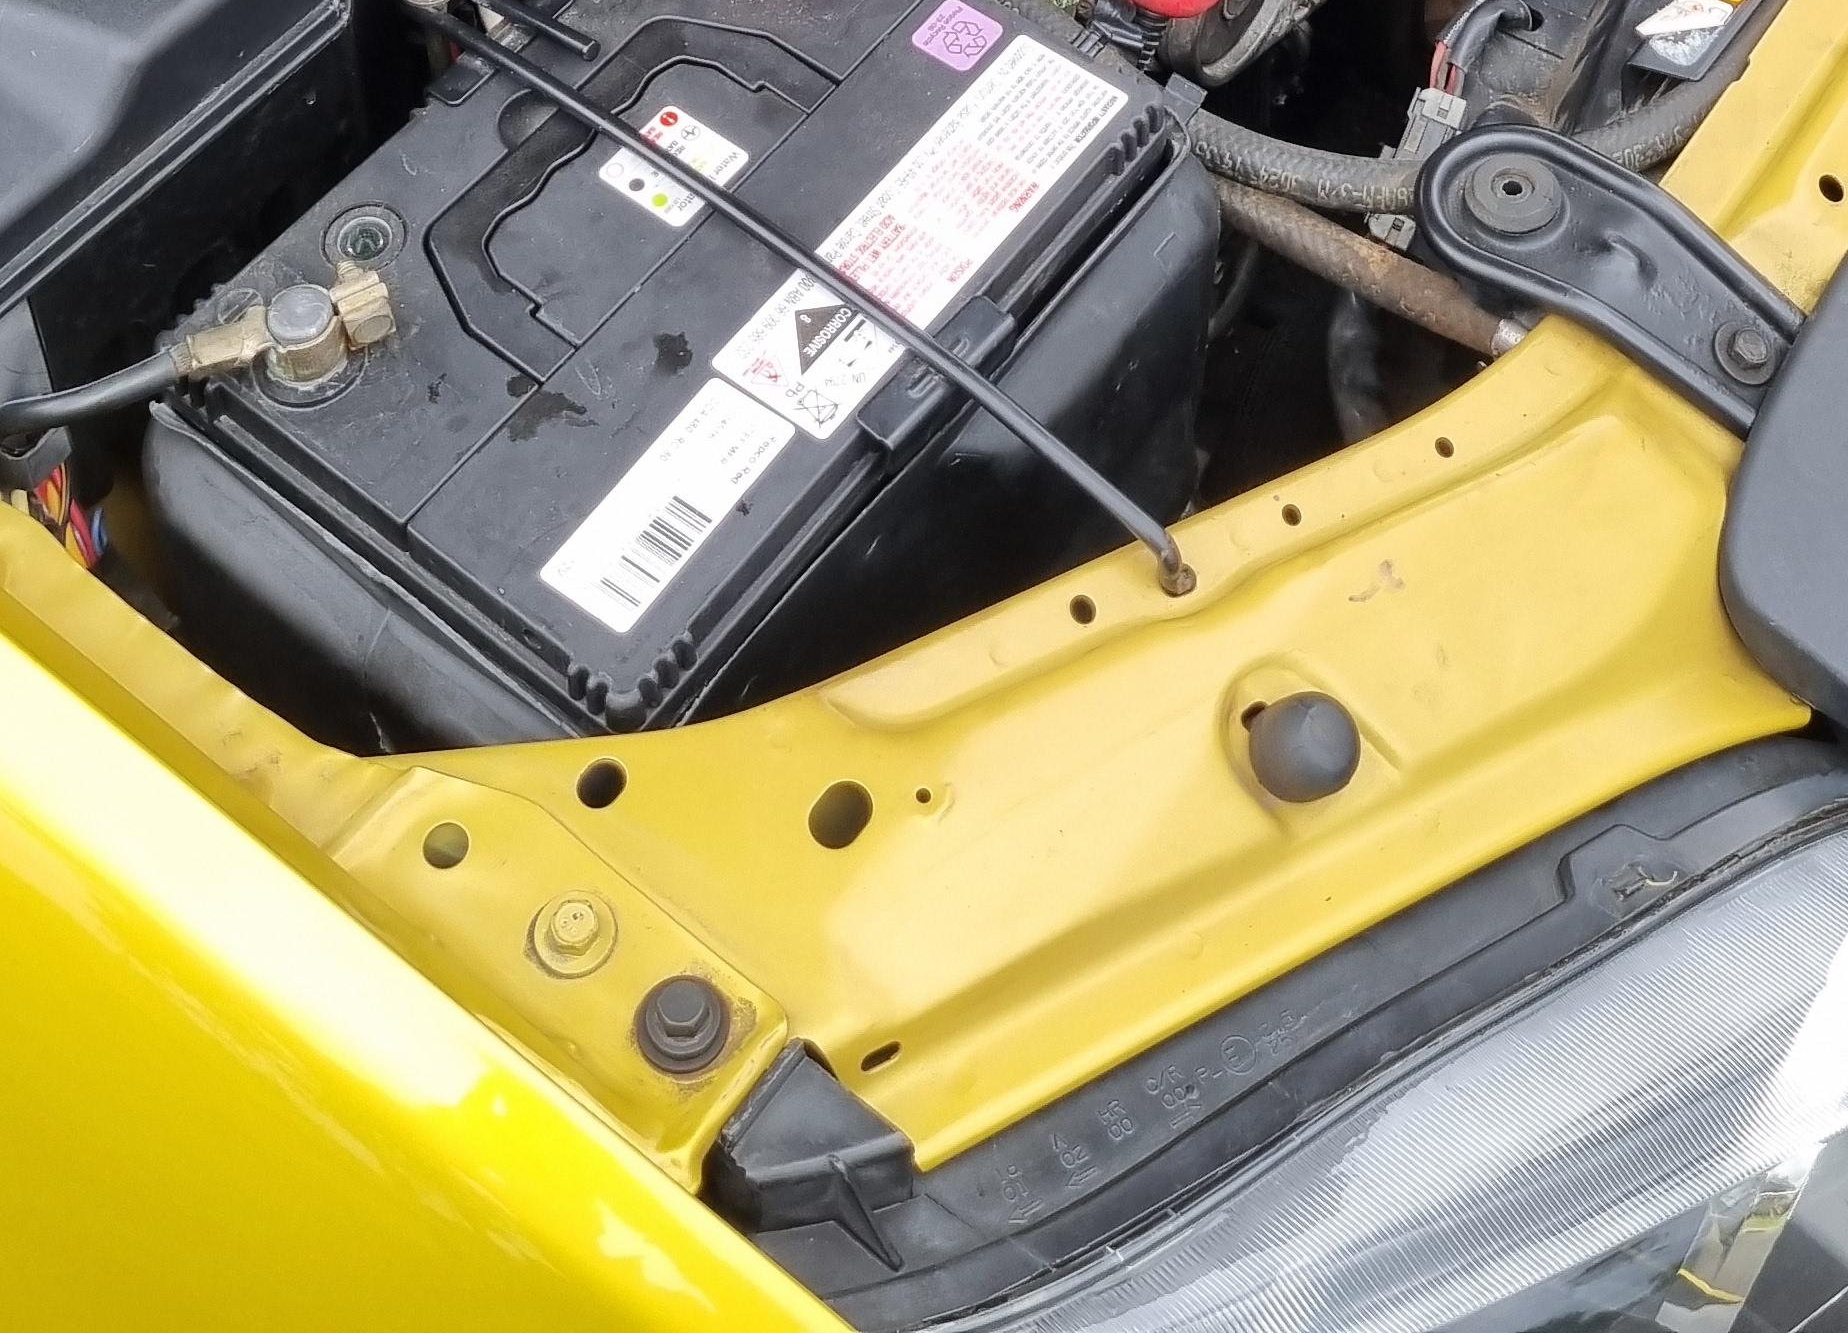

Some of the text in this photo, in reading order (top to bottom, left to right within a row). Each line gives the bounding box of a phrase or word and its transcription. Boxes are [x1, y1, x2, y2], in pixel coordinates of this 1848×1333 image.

[711, 150, 739, 175] Water
[798, 311, 811, 324] 8
[801, 303, 853, 360] CORROSIVE
[852, 372, 865, 382] UN
[783, 379, 805, 401] Pb
[747, 434, 776, 465] Repco
[730, 464, 750, 486] Red
[1096, 1097, 1126, 1125] HR
[1106, 1116, 1136, 1142] 00
[1058, 1143, 1089, 1171] 02
